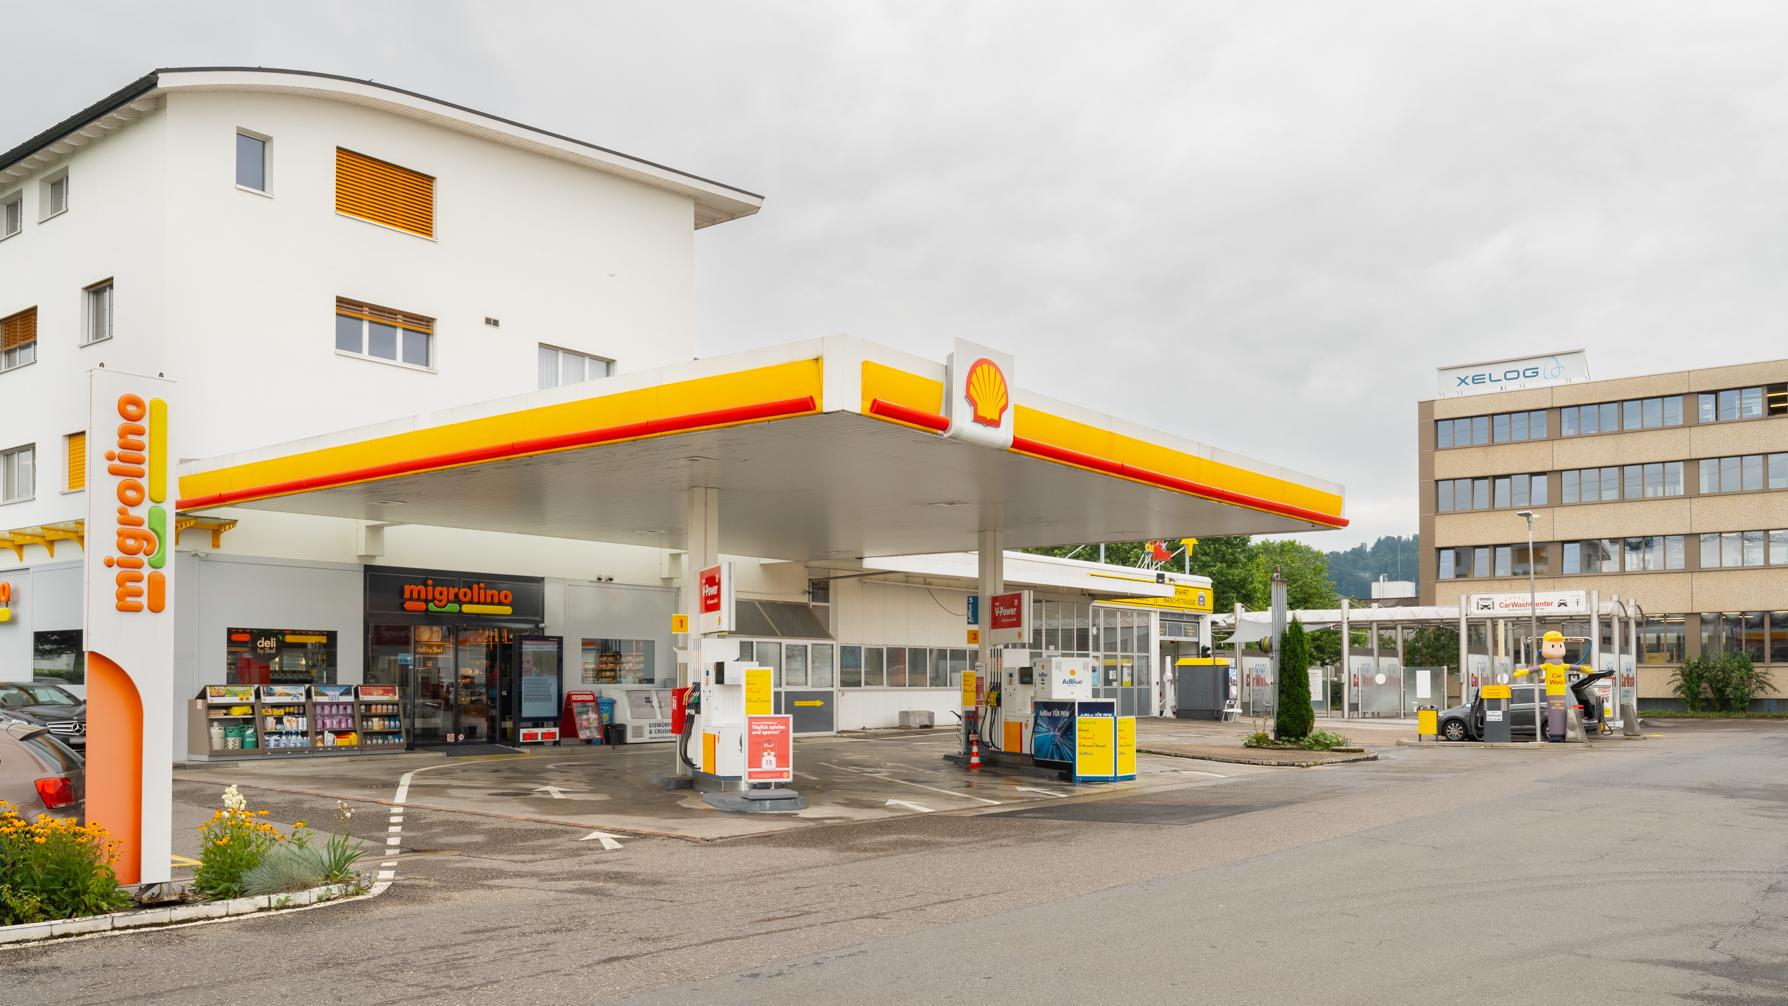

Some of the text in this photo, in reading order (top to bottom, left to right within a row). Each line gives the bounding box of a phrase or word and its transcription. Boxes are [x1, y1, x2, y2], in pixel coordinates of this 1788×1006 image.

[1456, 367, 1540, 387] XELOG
[104, 393, 158, 612] migrolino
[403, 579, 513, 607] migrolino
[994, 606, 1016, 616] V-Power
[257, 637, 276, 648] deli
